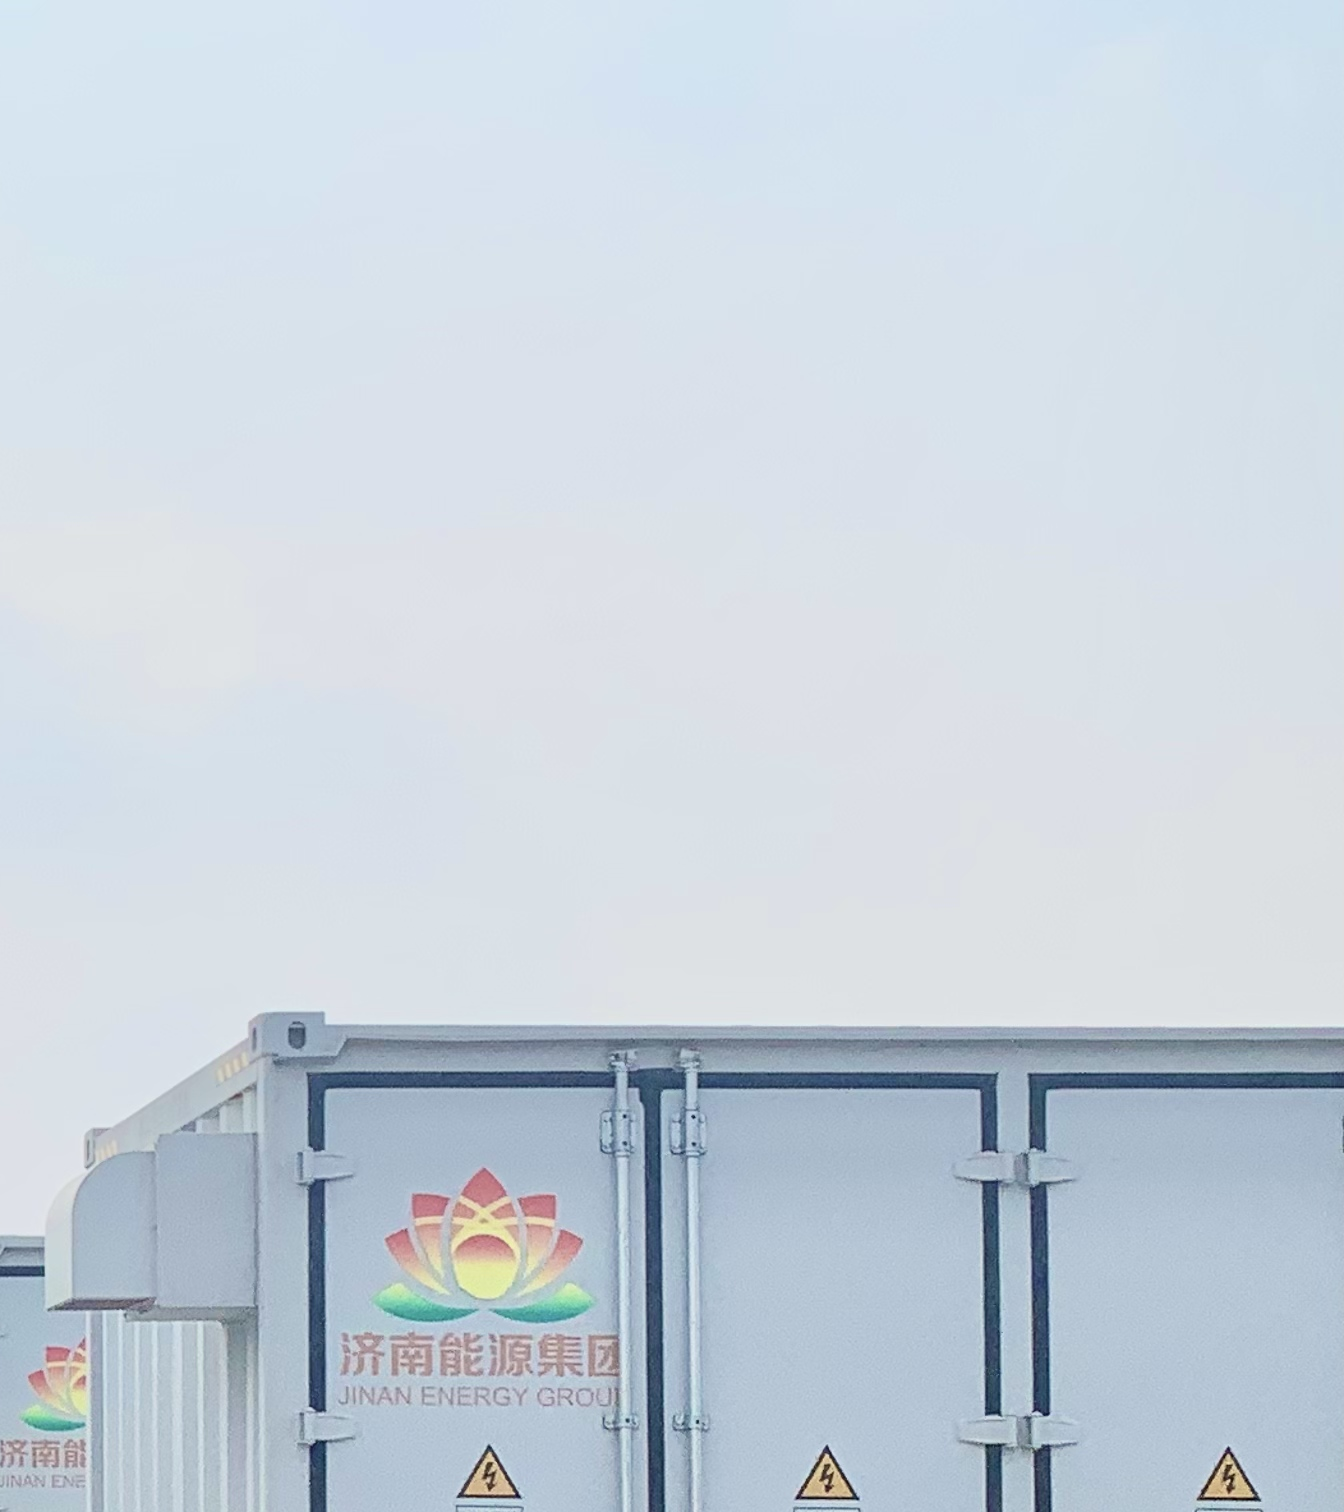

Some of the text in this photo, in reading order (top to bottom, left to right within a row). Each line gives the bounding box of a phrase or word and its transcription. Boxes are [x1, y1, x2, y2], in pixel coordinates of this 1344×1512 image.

[340, 1332, 621, 1377] 济南能源集团
[338, 1386, 411, 1406] JINAN
[421, 1386, 528, 1407] ENERGY
[51, 1474, 86, 1489] ENE
